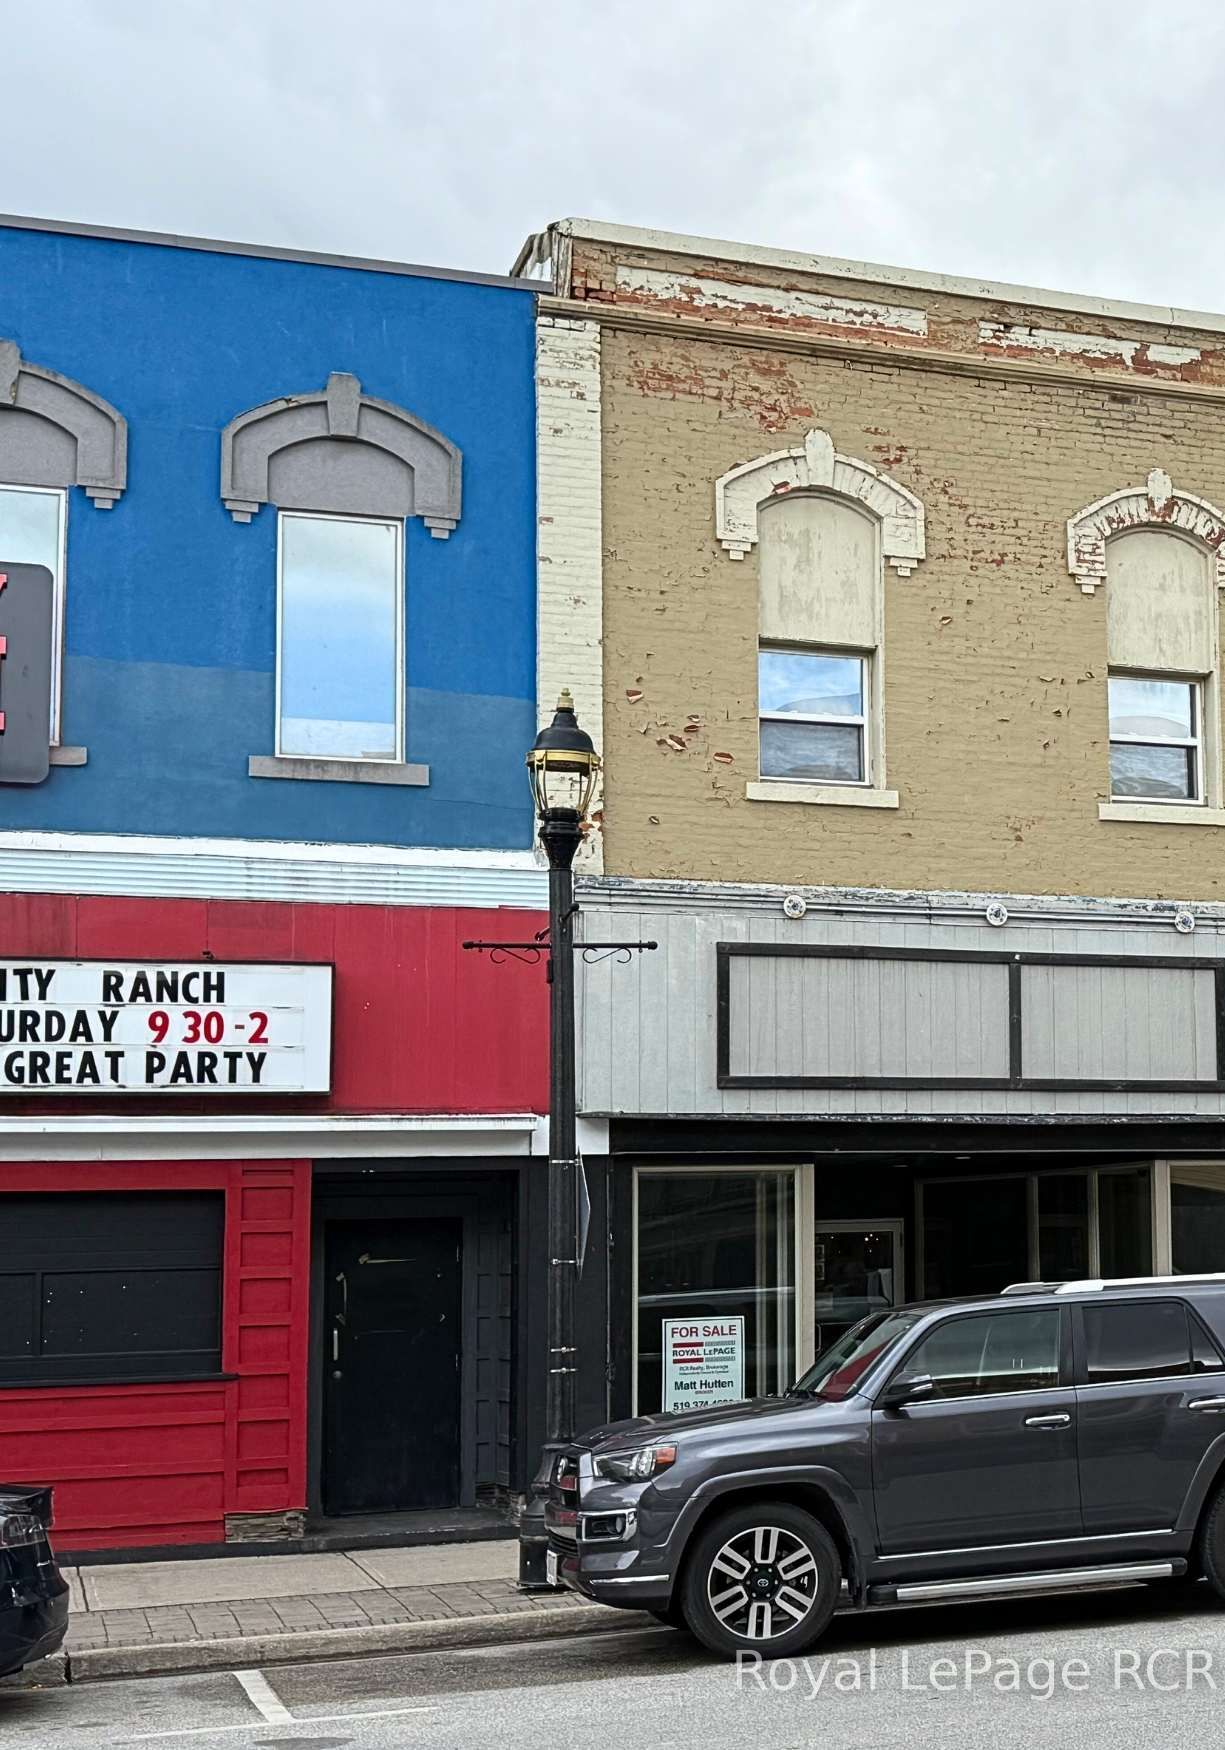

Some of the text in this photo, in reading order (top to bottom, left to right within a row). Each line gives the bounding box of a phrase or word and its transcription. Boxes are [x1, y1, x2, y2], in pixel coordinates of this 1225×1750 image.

[103, 970, 225, 1004] RANCH
[4, 1051, 267, 1084] GREAT PARTY
[671, 1325, 737, 1338] FOR SALE
[673, 1349, 701, 1357] ROYAL
[674, 1380, 733, 1390] Matt Hutten
